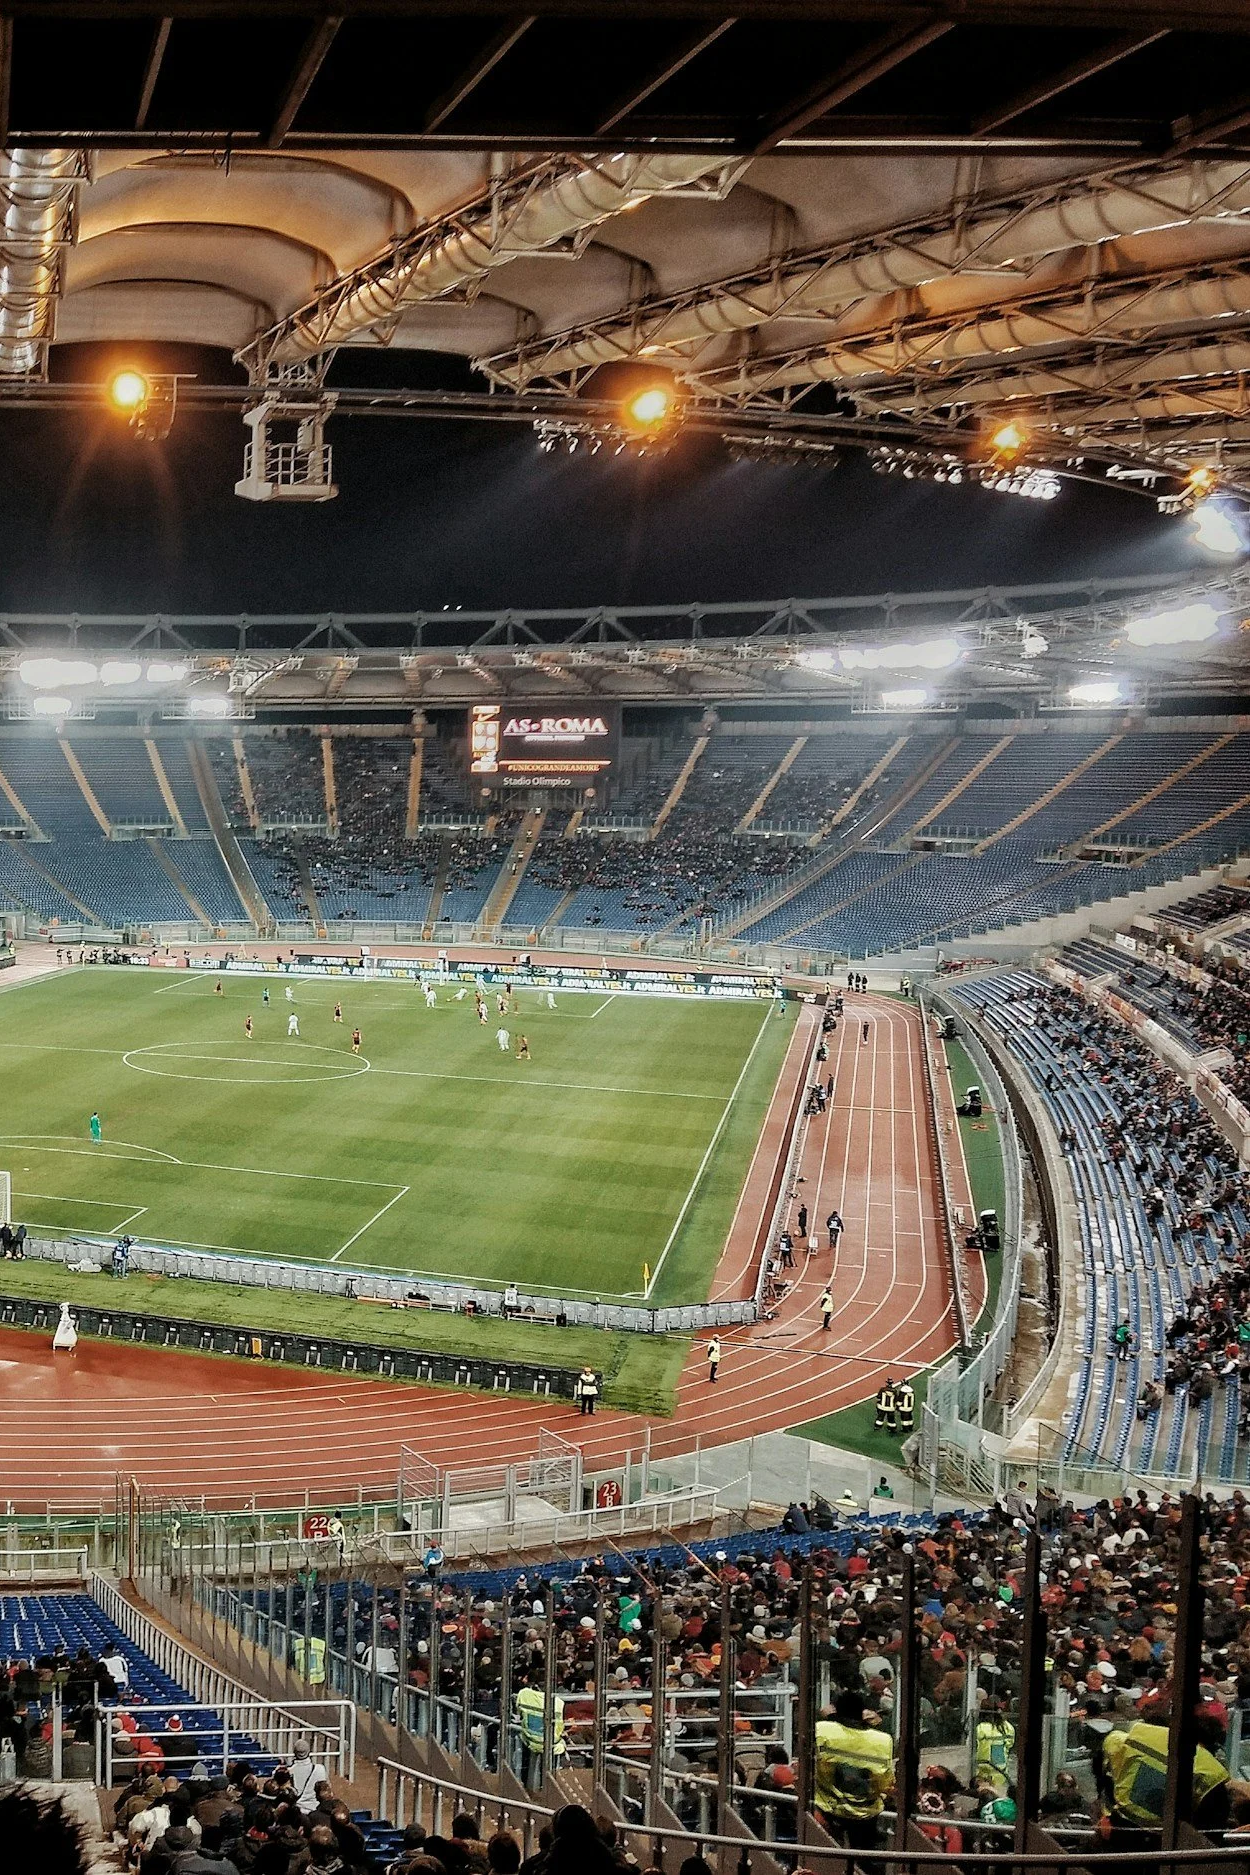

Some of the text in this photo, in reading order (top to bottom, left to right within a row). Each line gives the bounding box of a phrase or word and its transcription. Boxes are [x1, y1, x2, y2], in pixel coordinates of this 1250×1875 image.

[540, 717, 609, 733] ROMA
[507, 764, 600, 772] #UNICOGRANDEAMORE
[503, 777, 571, 788] Stadio Olimpico
[602, 1482, 617, 1497] 23
[310, 1516, 328, 1529] 22
